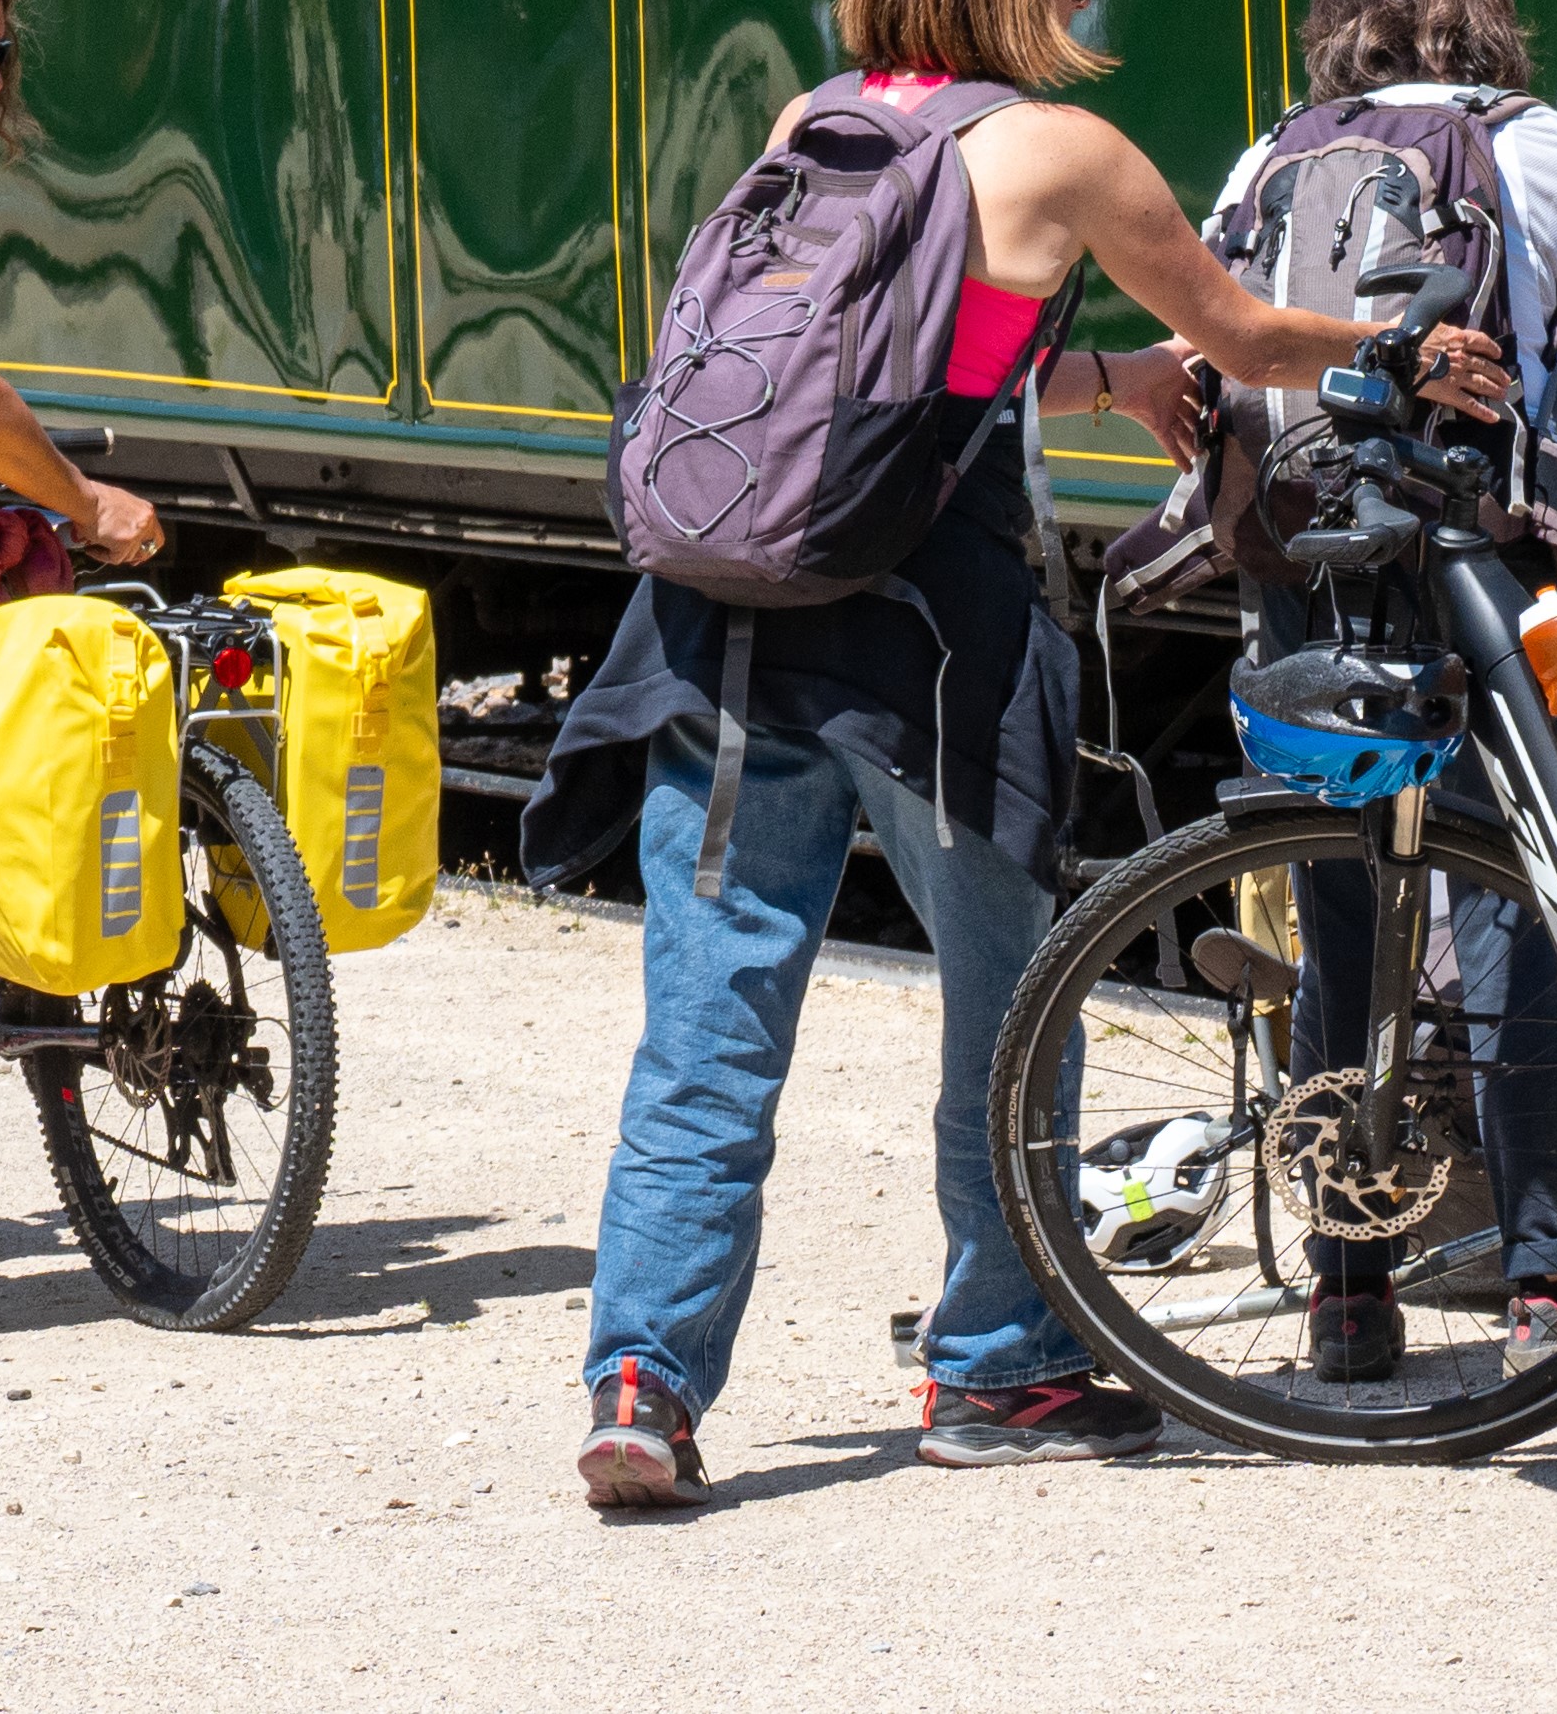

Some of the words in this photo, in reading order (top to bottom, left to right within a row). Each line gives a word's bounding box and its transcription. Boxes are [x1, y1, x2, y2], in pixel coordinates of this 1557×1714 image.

[1007, 1079, 1020, 1144] MONDIAL
[59, 1166, 137, 1288] SCHWALBE
[1019, 1203, 1058, 1279] SCHWALBE
